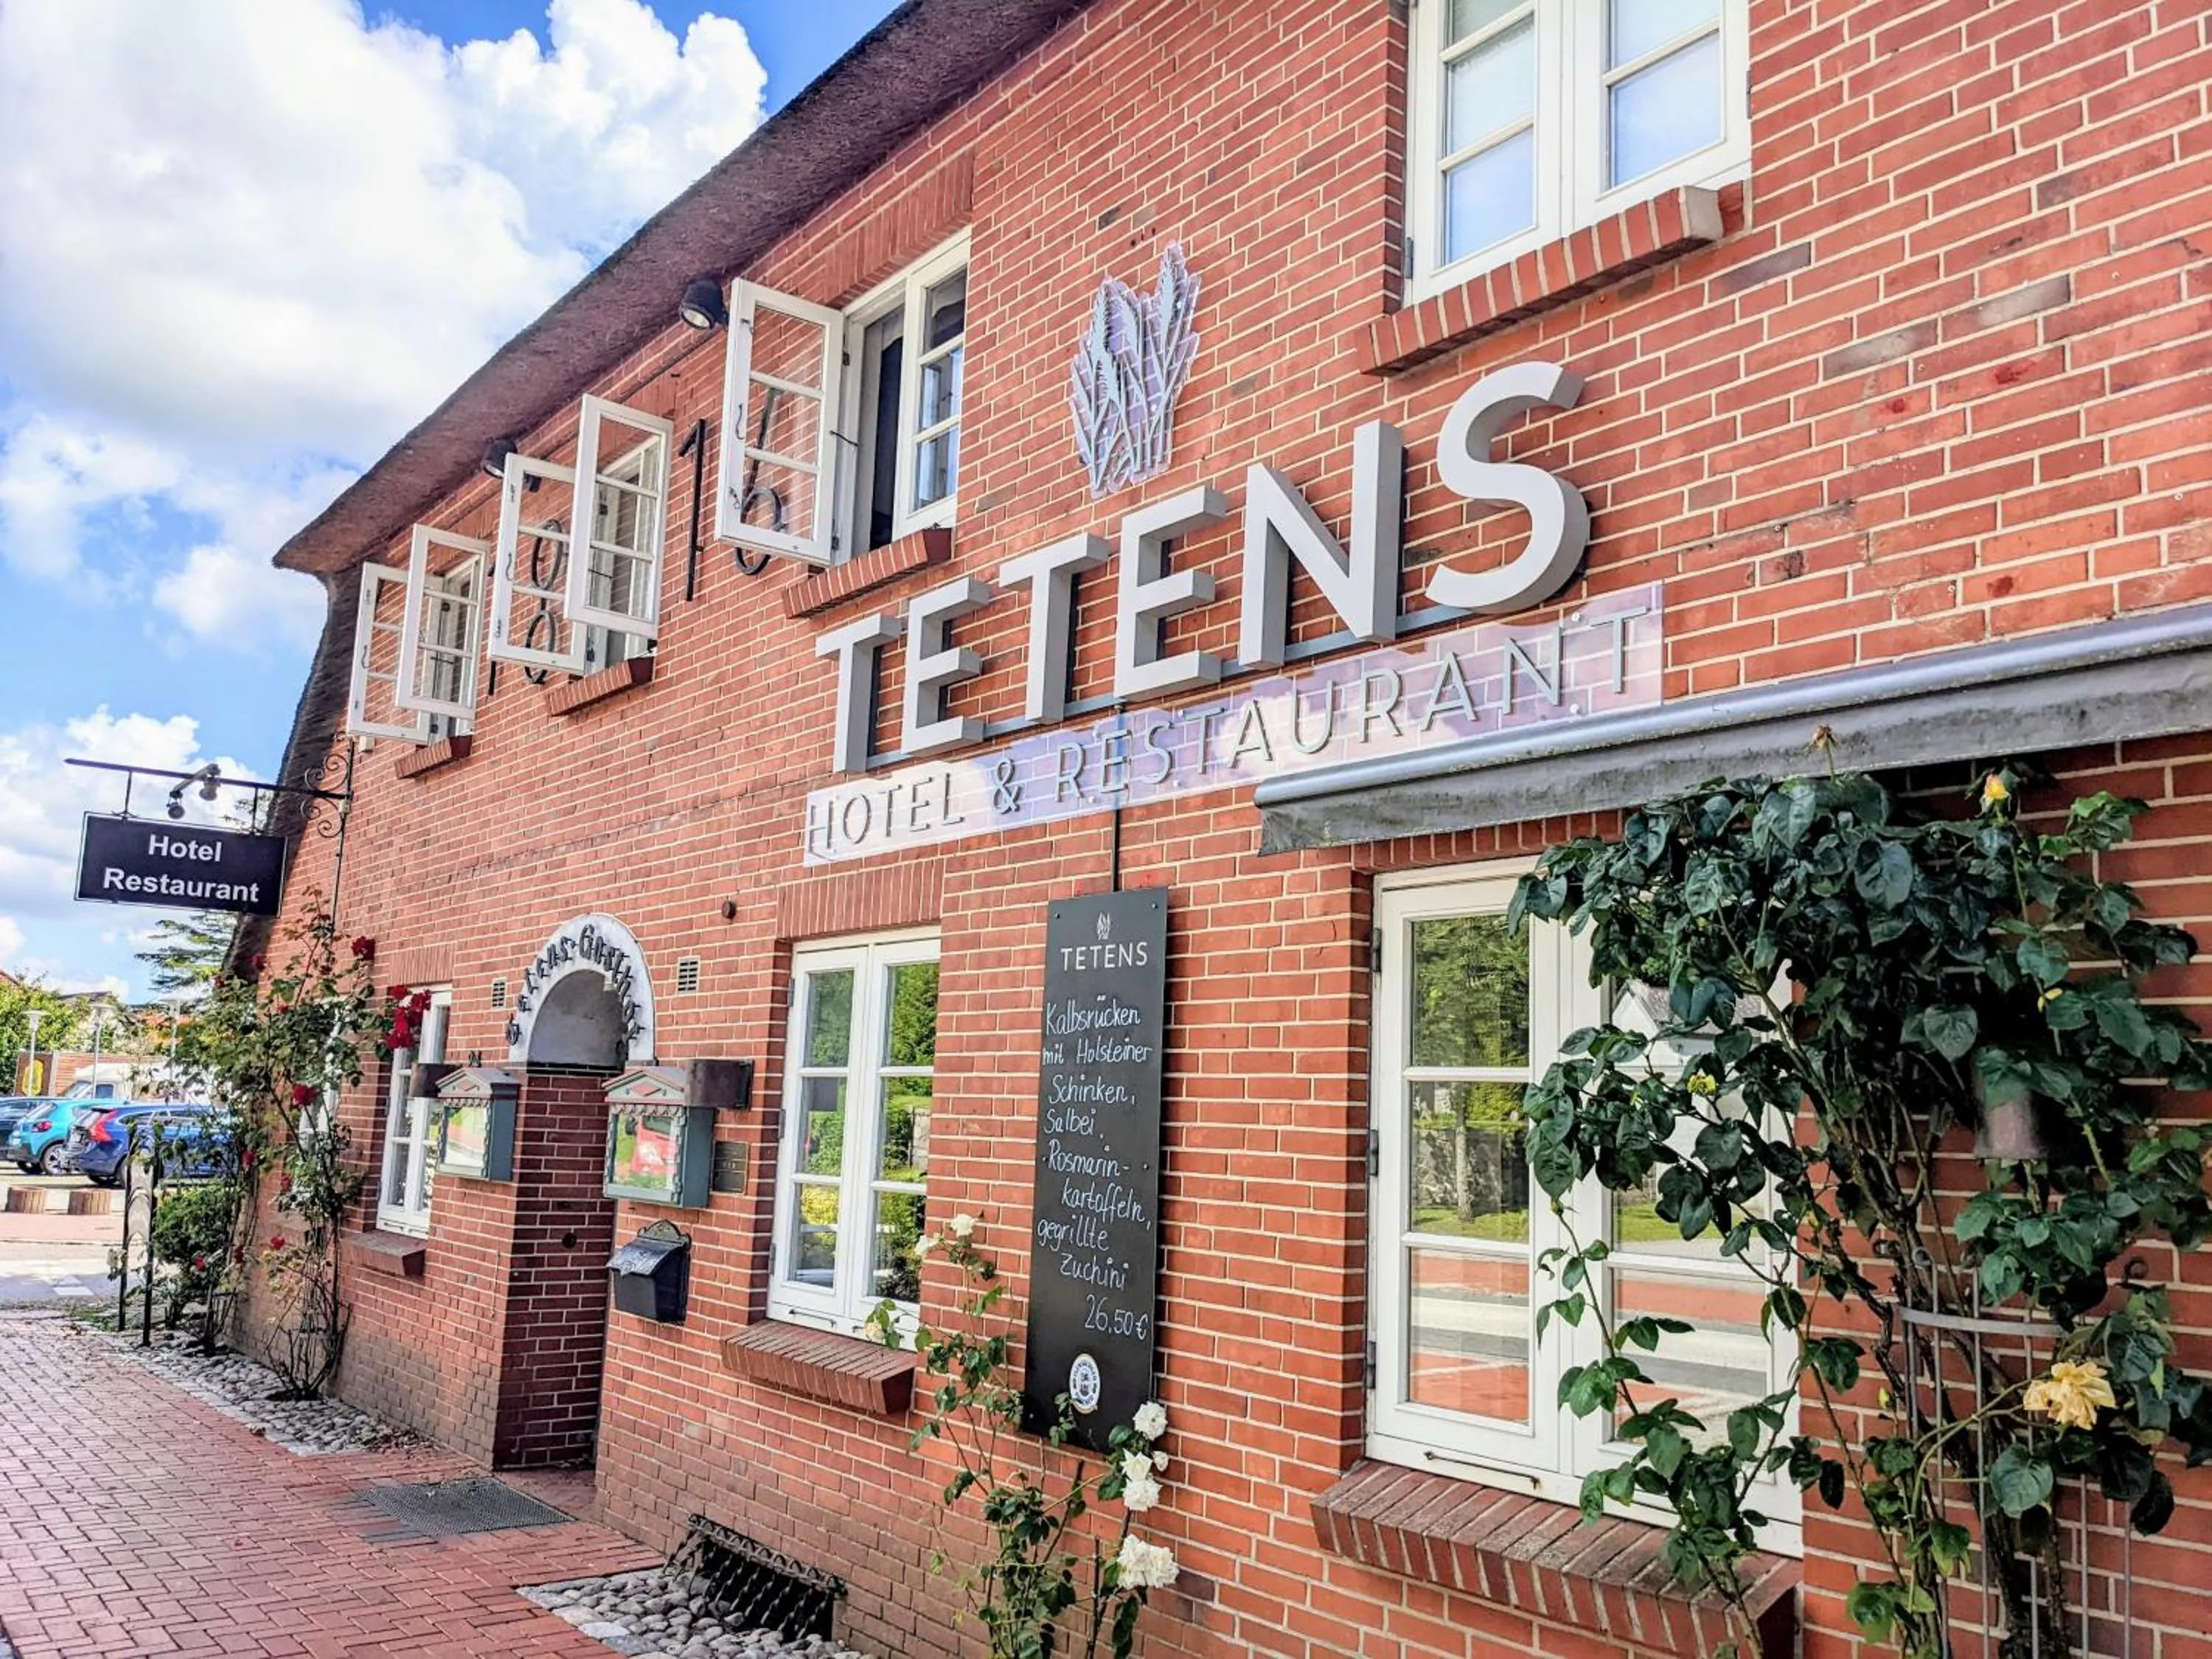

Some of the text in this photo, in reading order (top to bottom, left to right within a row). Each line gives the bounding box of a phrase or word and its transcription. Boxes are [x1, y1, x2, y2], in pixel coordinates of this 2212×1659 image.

[815, 361, 1593, 773] TETENS
[808, 605, 1649, 850] HOTEL & RESTAURANT
[148, 834, 222, 862] Hotel
[103, 868, 259, 902] Restaurant
[1060, 942, 1148, 971] TETENS
[1046, 995, 1141, 1035] Kalbsrücken
[1042, 1035, 1153, 1066] mit Holsteiner
[1048, 1074, 1136, 1105] Schinken,
[1037, 1214, 1110, 1252] gegrillte
[1060, 1253, 1130, 1292] Zuchini
